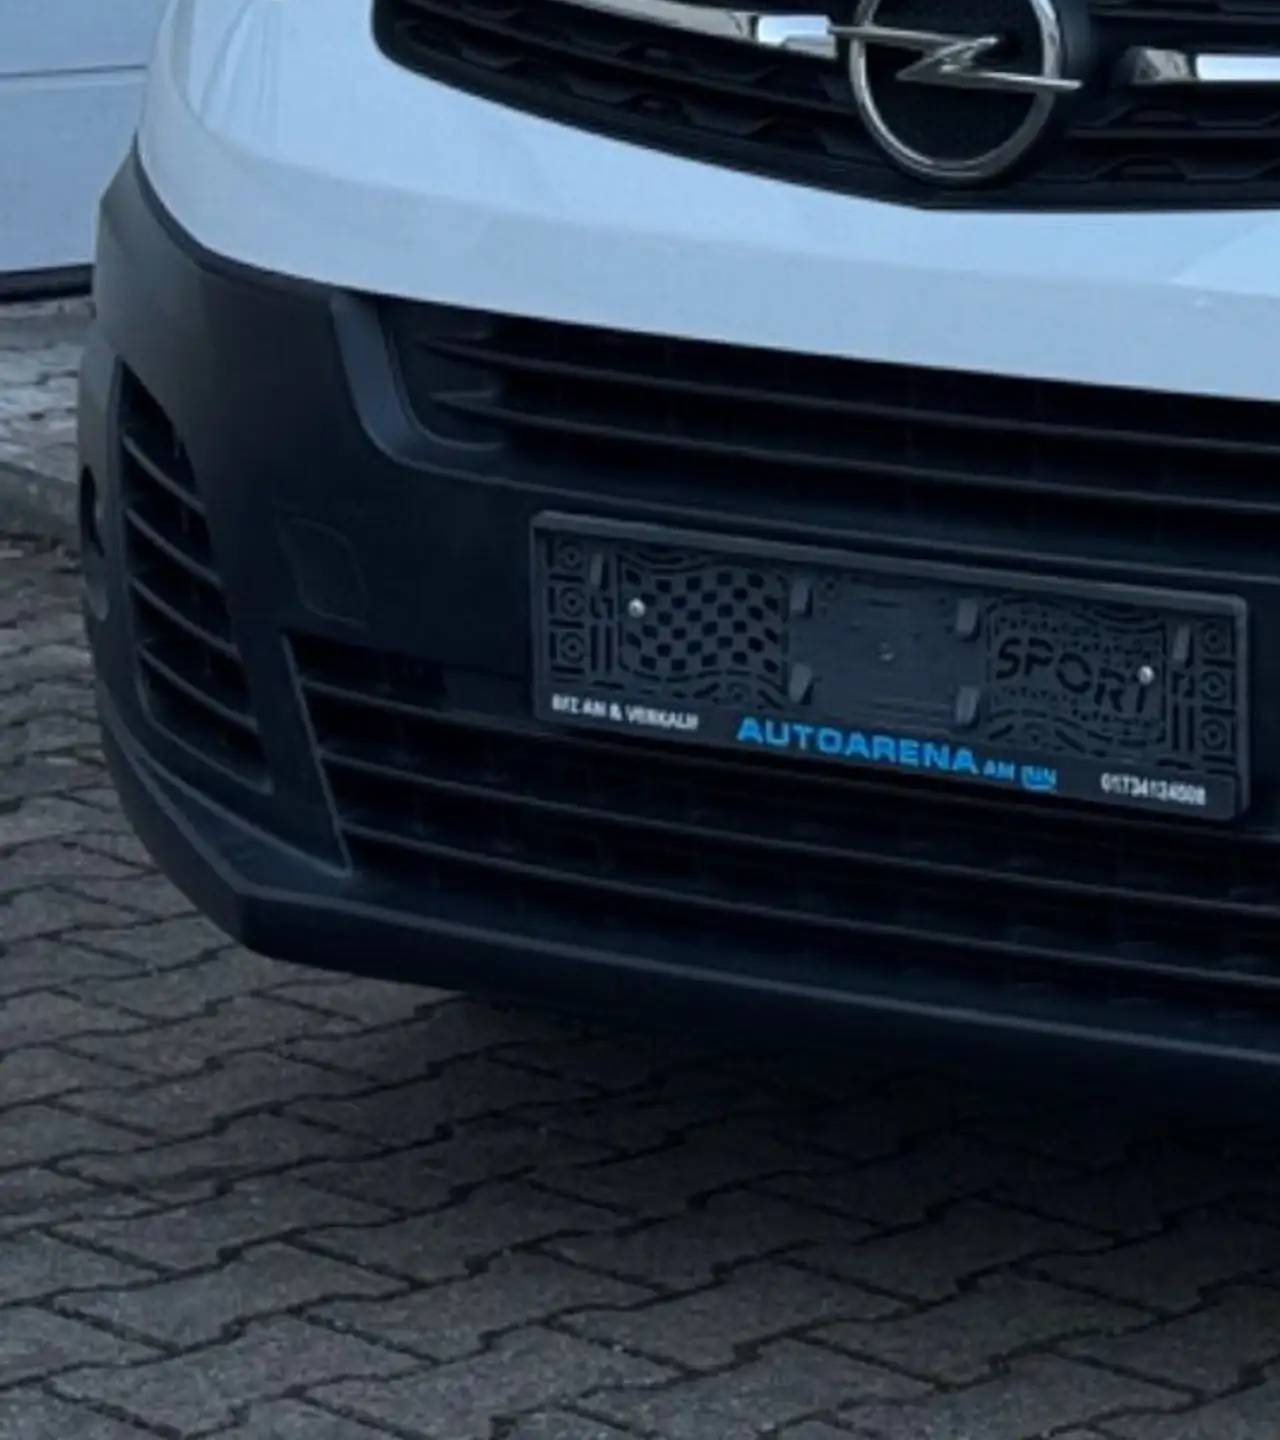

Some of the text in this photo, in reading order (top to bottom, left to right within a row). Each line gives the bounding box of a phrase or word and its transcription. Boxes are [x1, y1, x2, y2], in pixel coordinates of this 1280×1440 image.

[608, 701, 624, 722] &
[736, 716, 980, 775] AUTOARENA
[982, 758, 1016, 783] AM
